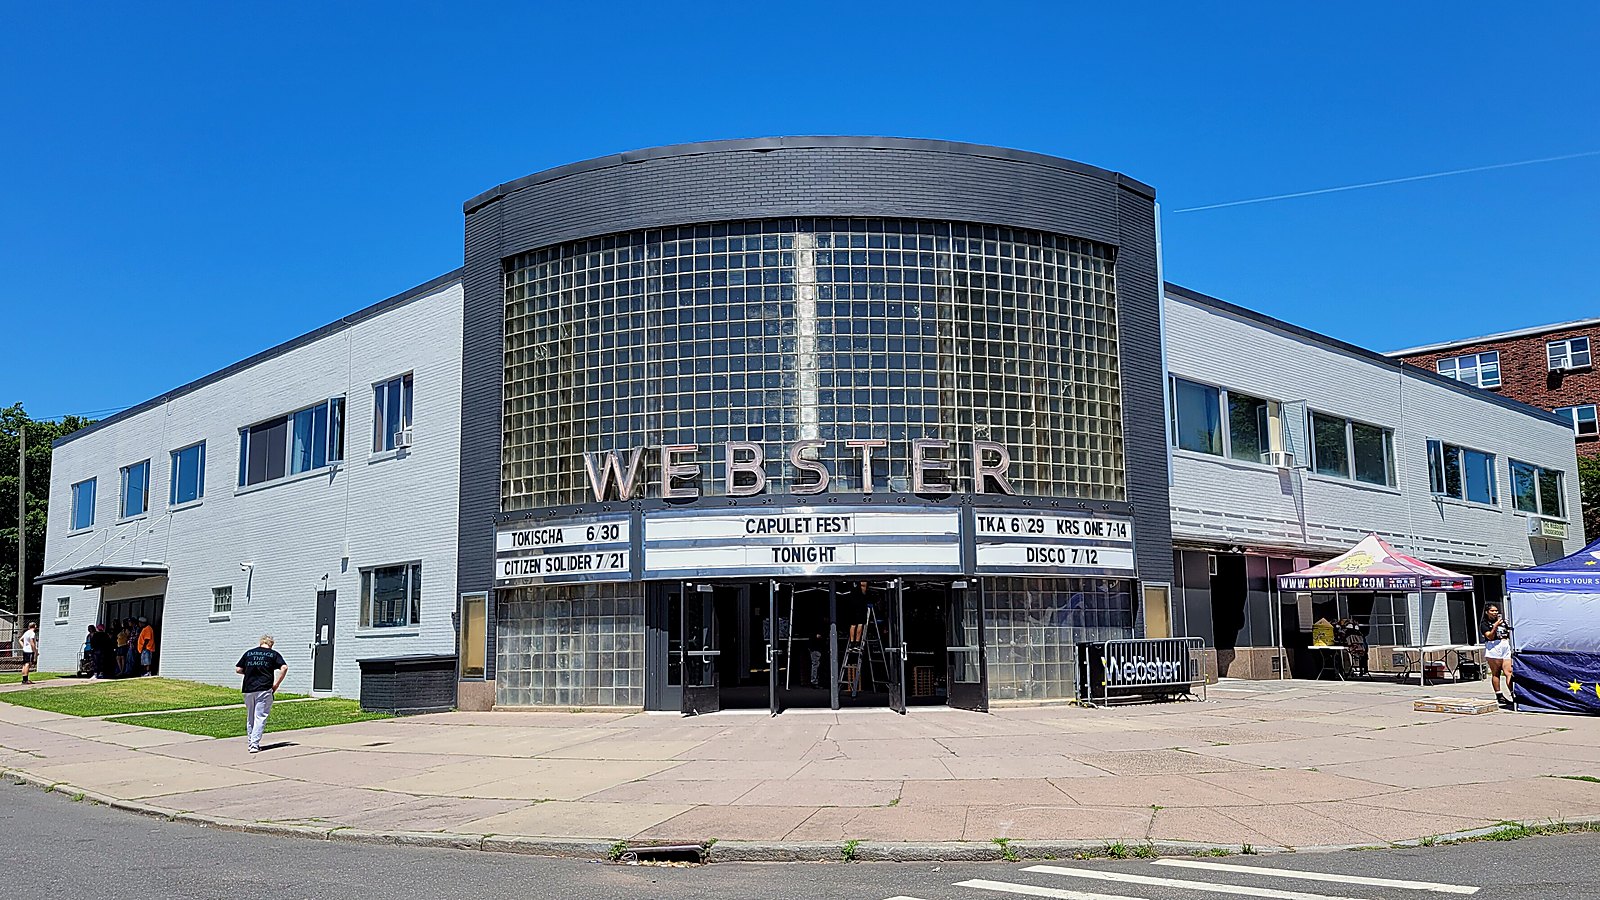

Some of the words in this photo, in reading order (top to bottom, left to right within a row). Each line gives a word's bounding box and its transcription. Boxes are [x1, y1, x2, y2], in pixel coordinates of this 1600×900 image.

[583, 438, 1016, 502] WEBSTER
[512, 529, 563, 546] TOKISCHA
[586, 524, 620, 541] 6/30
[746, 518, 812, 534] CAPULET
[816, 517, 850, 533] FEST
[978, 516, 1006, 532] TKA
[1057, 519, 1080, 535] KRS
[1084, 521, 1103, 536] ONE
[1106, 522, 1127, 537] 7-14
[504, 559, 541, 575] CITIZEN
[545, 554, 592, 572] SOLIDER
[595, 553, 625, 569] 7/21
[772, 547, 836, 562] TONIGHT
[1026, 547, 1065, 564] DISCO
[1071, 549, 1098, 564] 7/12
[1280, 577, 1385, 589] WWW.MOSHITUP.COM
[1101, 655, 1181, 681] Webster
